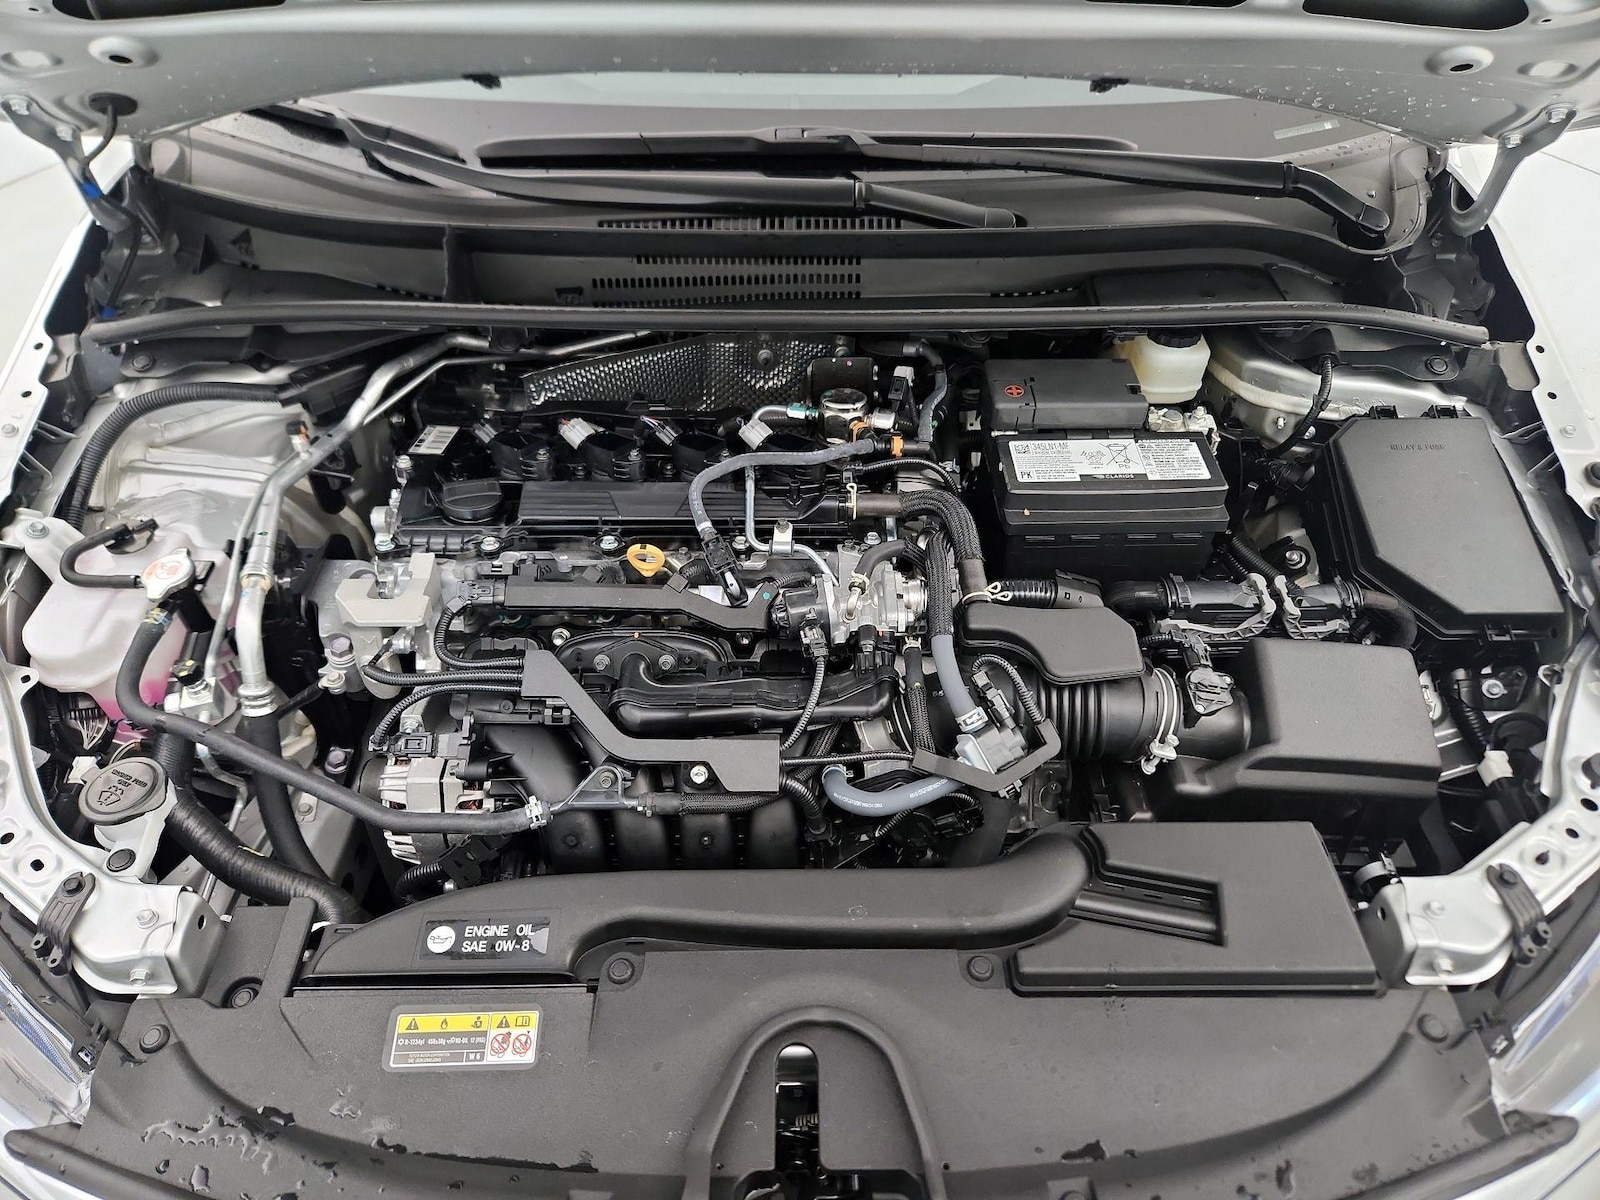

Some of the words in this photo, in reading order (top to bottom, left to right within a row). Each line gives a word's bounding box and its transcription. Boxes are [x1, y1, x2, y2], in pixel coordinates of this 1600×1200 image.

[1389, 443, 1415, 451] RELAY
[1020, 471, 1033, 479] PK
[464, 925, 509, 938] ENGINE
[516, 924, 536, 936] OIL
[461, 940, 488, 953] SAE
[495, 939, 530, 952] 0W-8
